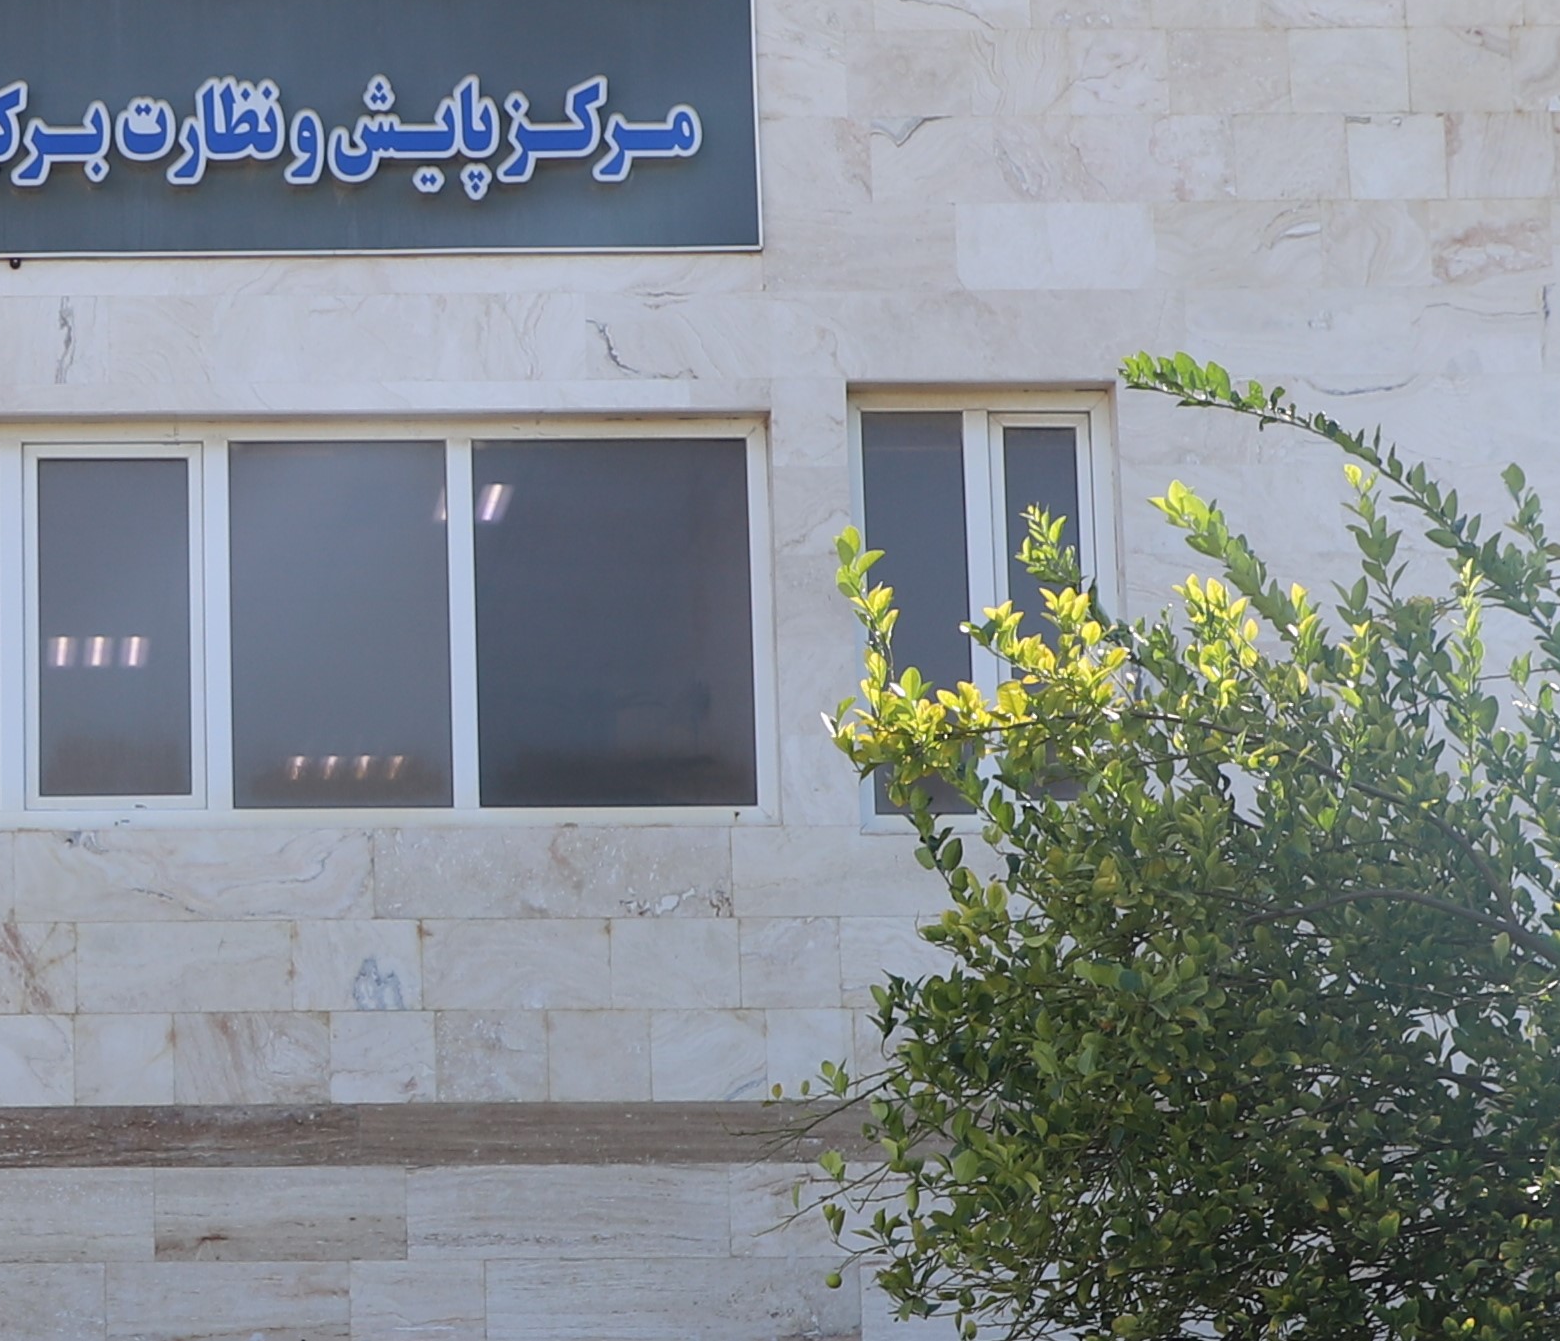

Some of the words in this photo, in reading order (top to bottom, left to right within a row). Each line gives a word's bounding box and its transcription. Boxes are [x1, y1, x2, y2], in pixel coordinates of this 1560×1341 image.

[13, 102, 109, 184] بر
[117, 78, 283, 183] نظارت
[286, 111, 323, 182] و
[329, 77, 498, 198] پایش
[498, 77, 700, 181] مرکز
